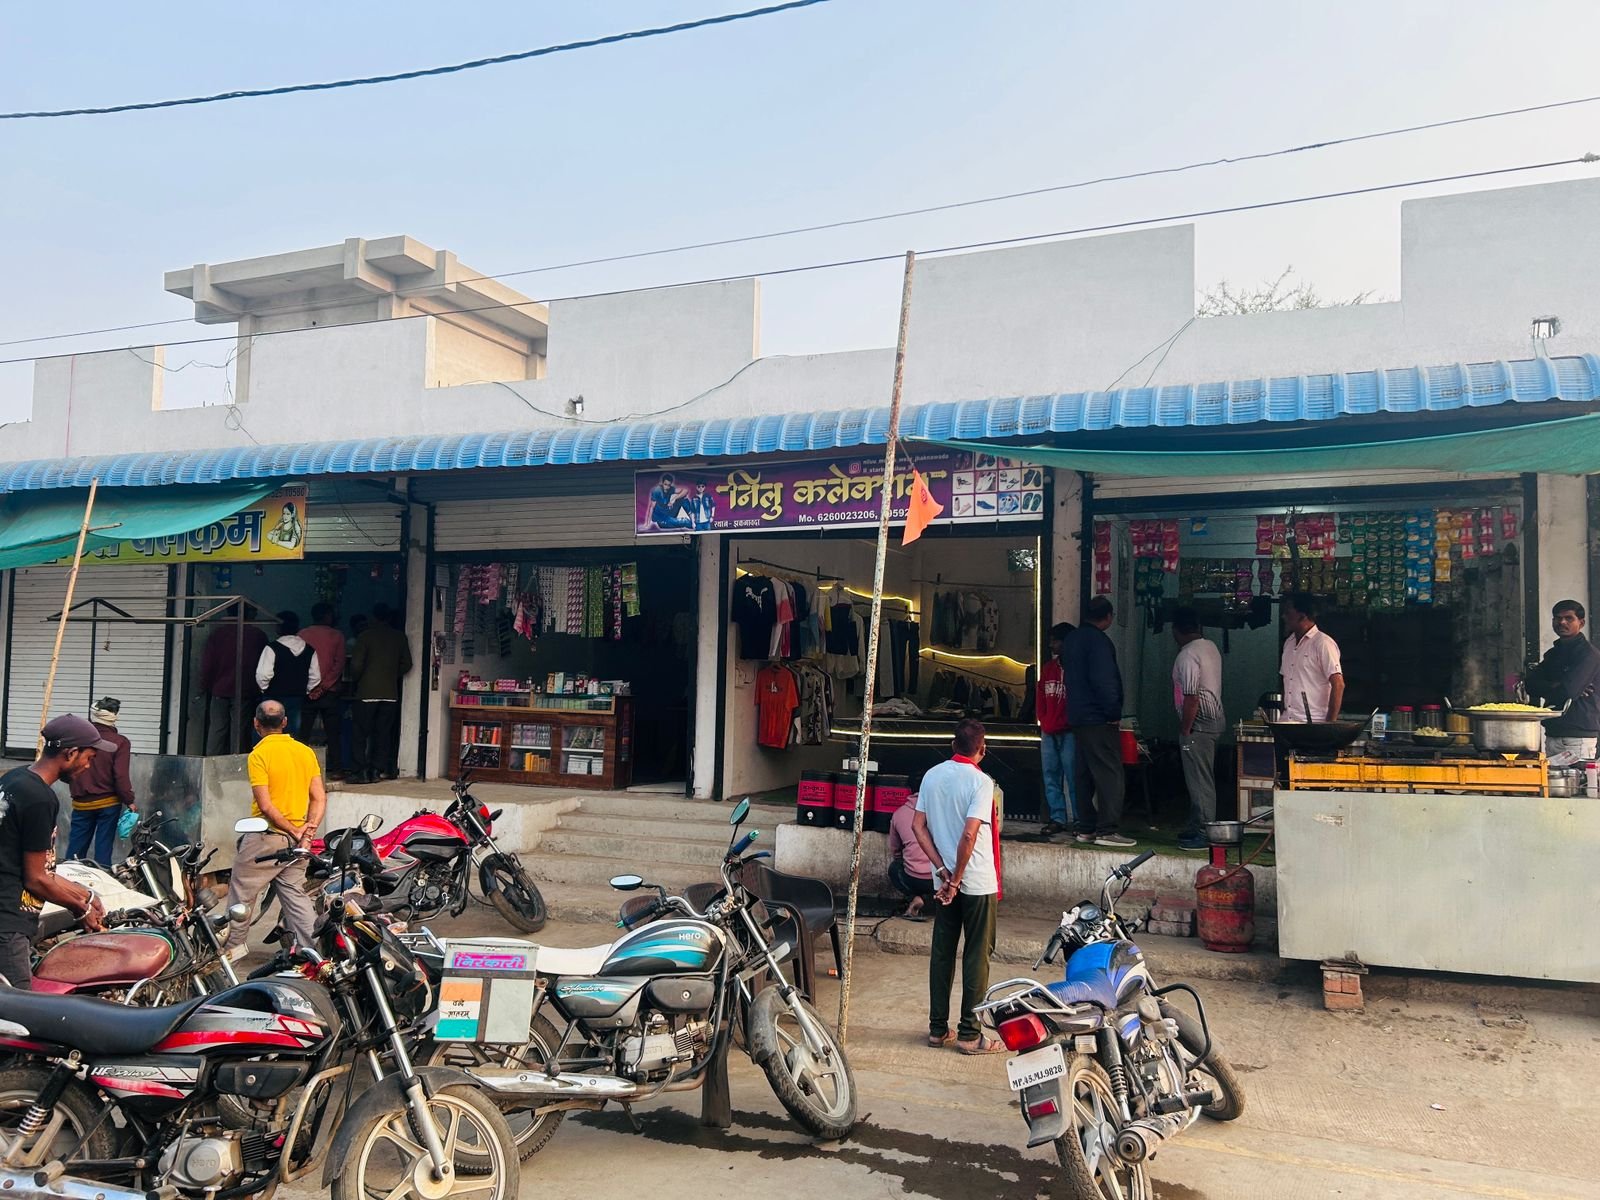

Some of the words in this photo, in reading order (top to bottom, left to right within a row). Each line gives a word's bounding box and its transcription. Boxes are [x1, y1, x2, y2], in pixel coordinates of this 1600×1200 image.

[798, 514, 815, 523] Mo.
[817, 510, 878, 522] 6260023206,
[678, 932, 702, 942] Hero
